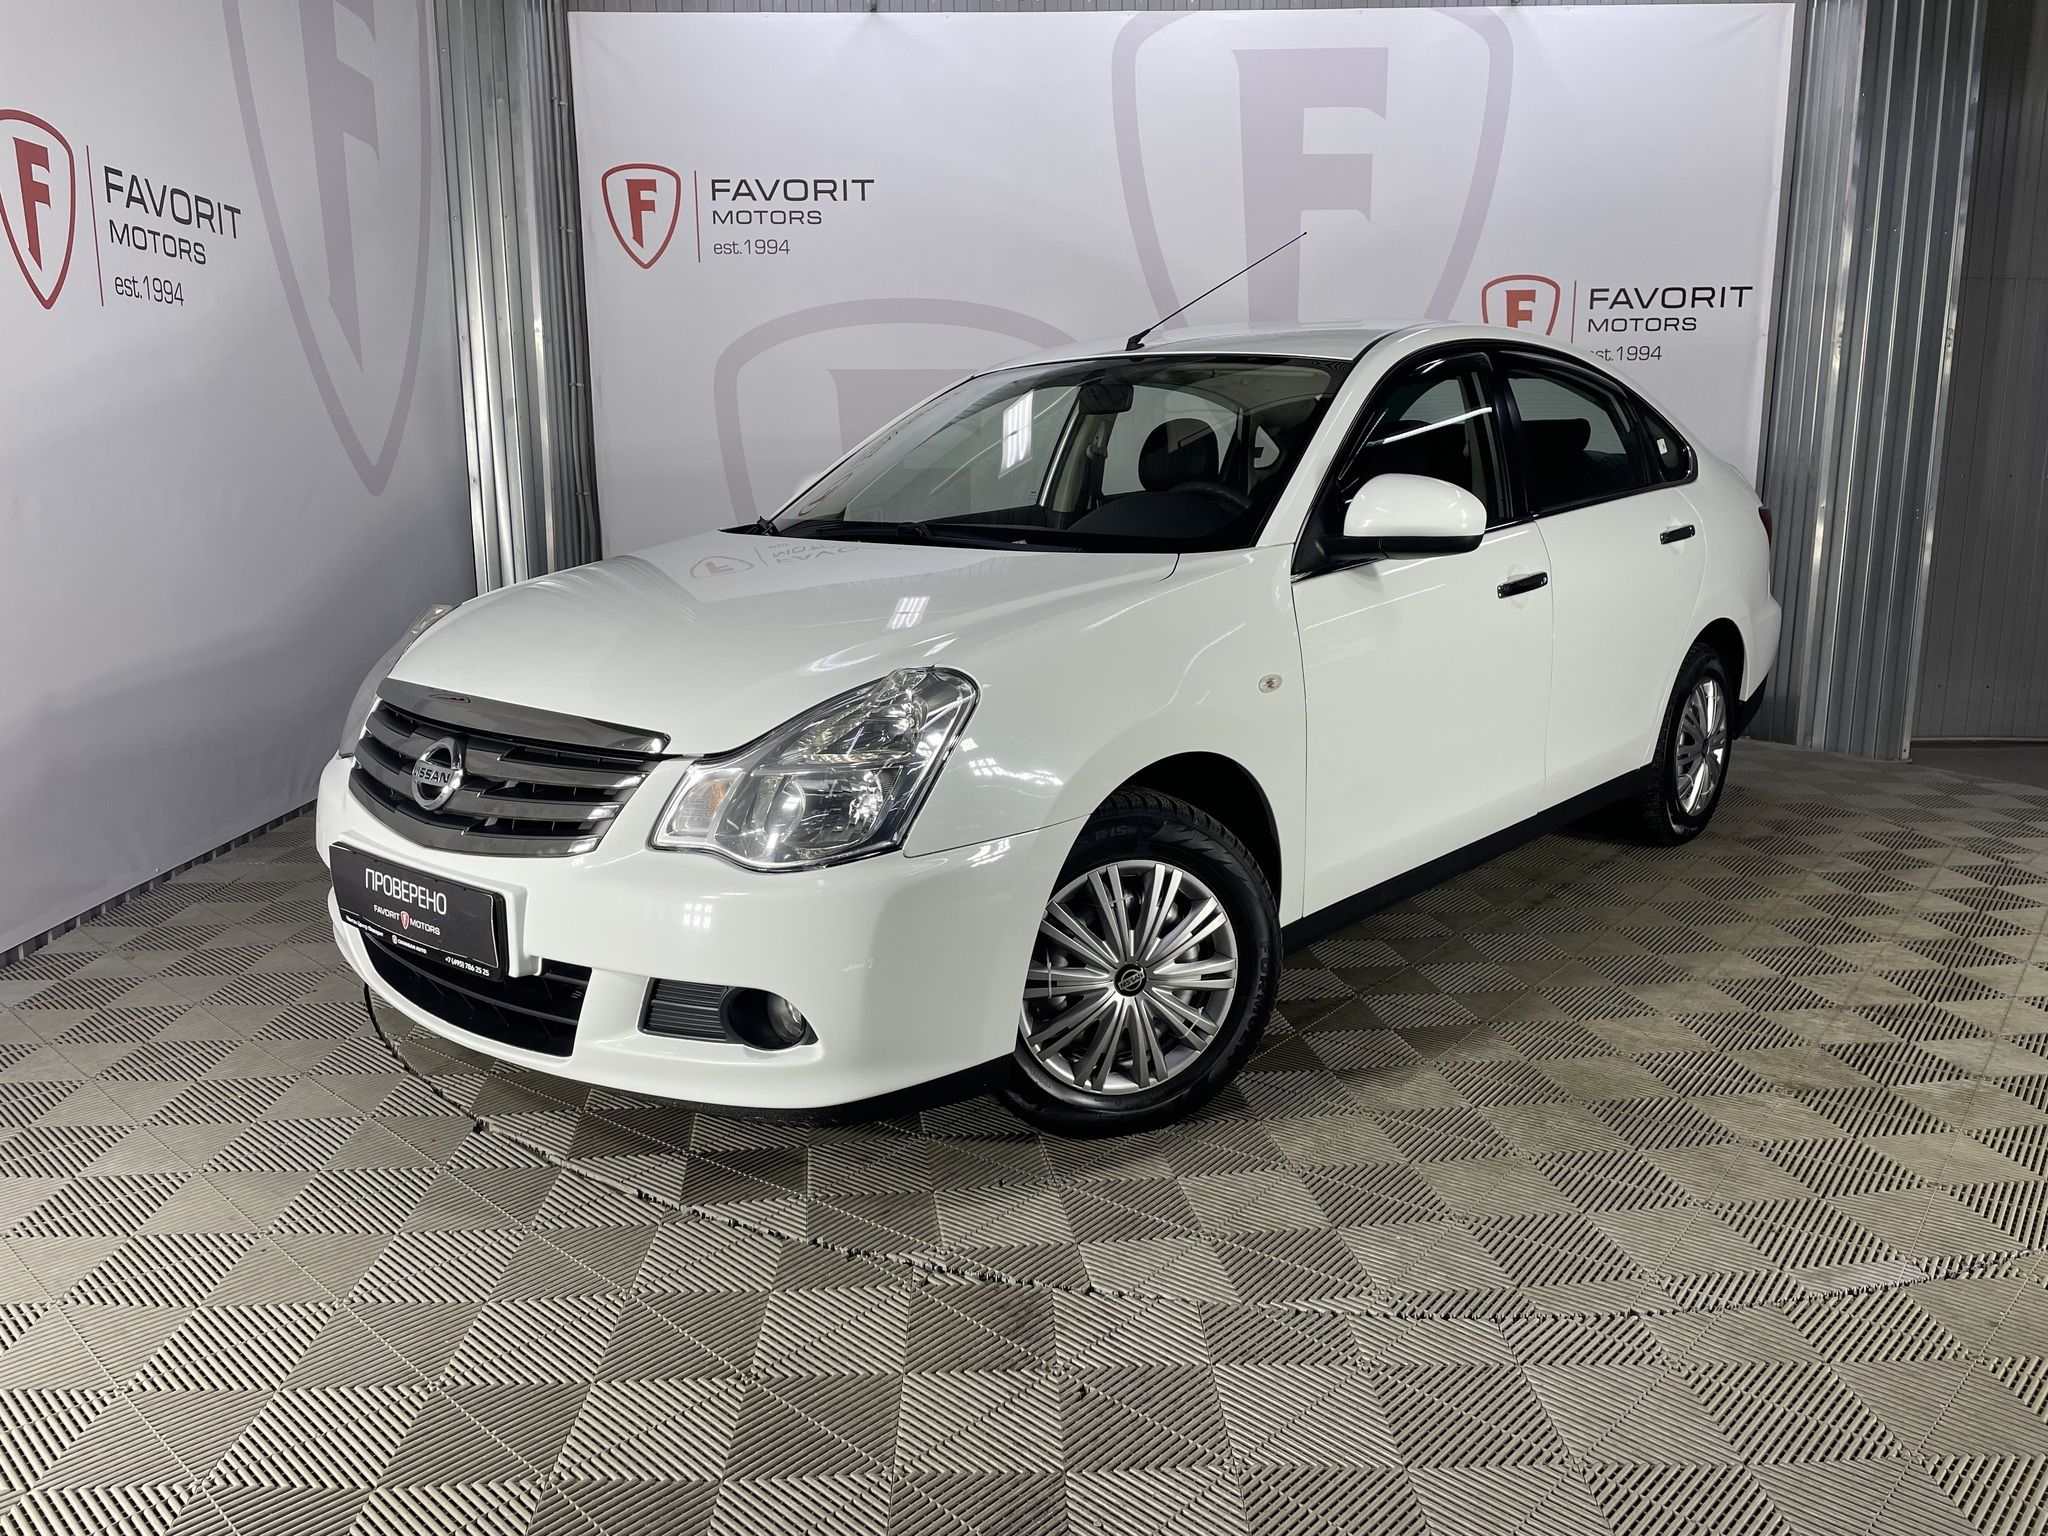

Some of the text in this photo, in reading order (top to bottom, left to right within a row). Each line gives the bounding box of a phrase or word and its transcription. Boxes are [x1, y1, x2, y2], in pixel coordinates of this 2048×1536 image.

[103, 165, 242, 239] FAVORIT
[710, 178, 875, 202] FAVORIT
[625, 178, 658, 249] F
[712, 210, 823, 225] MOTORS
[108, 219, 207, 265] MOTORS
[713, 239, 791, 255] est.1994
[114, 275, 185, 306] est.1994
[1589, 286, 1753, 310] FAVORIT
[1587, 317, 1697, 333] MOTORS
[1590, 345, 1663, 362] st.1994
[365, 867, 447, 915] ПРОВЕРЕНО
[373, 904, 401, 921] FAVORIT
[409, 917, 441, 936] MOTORS
